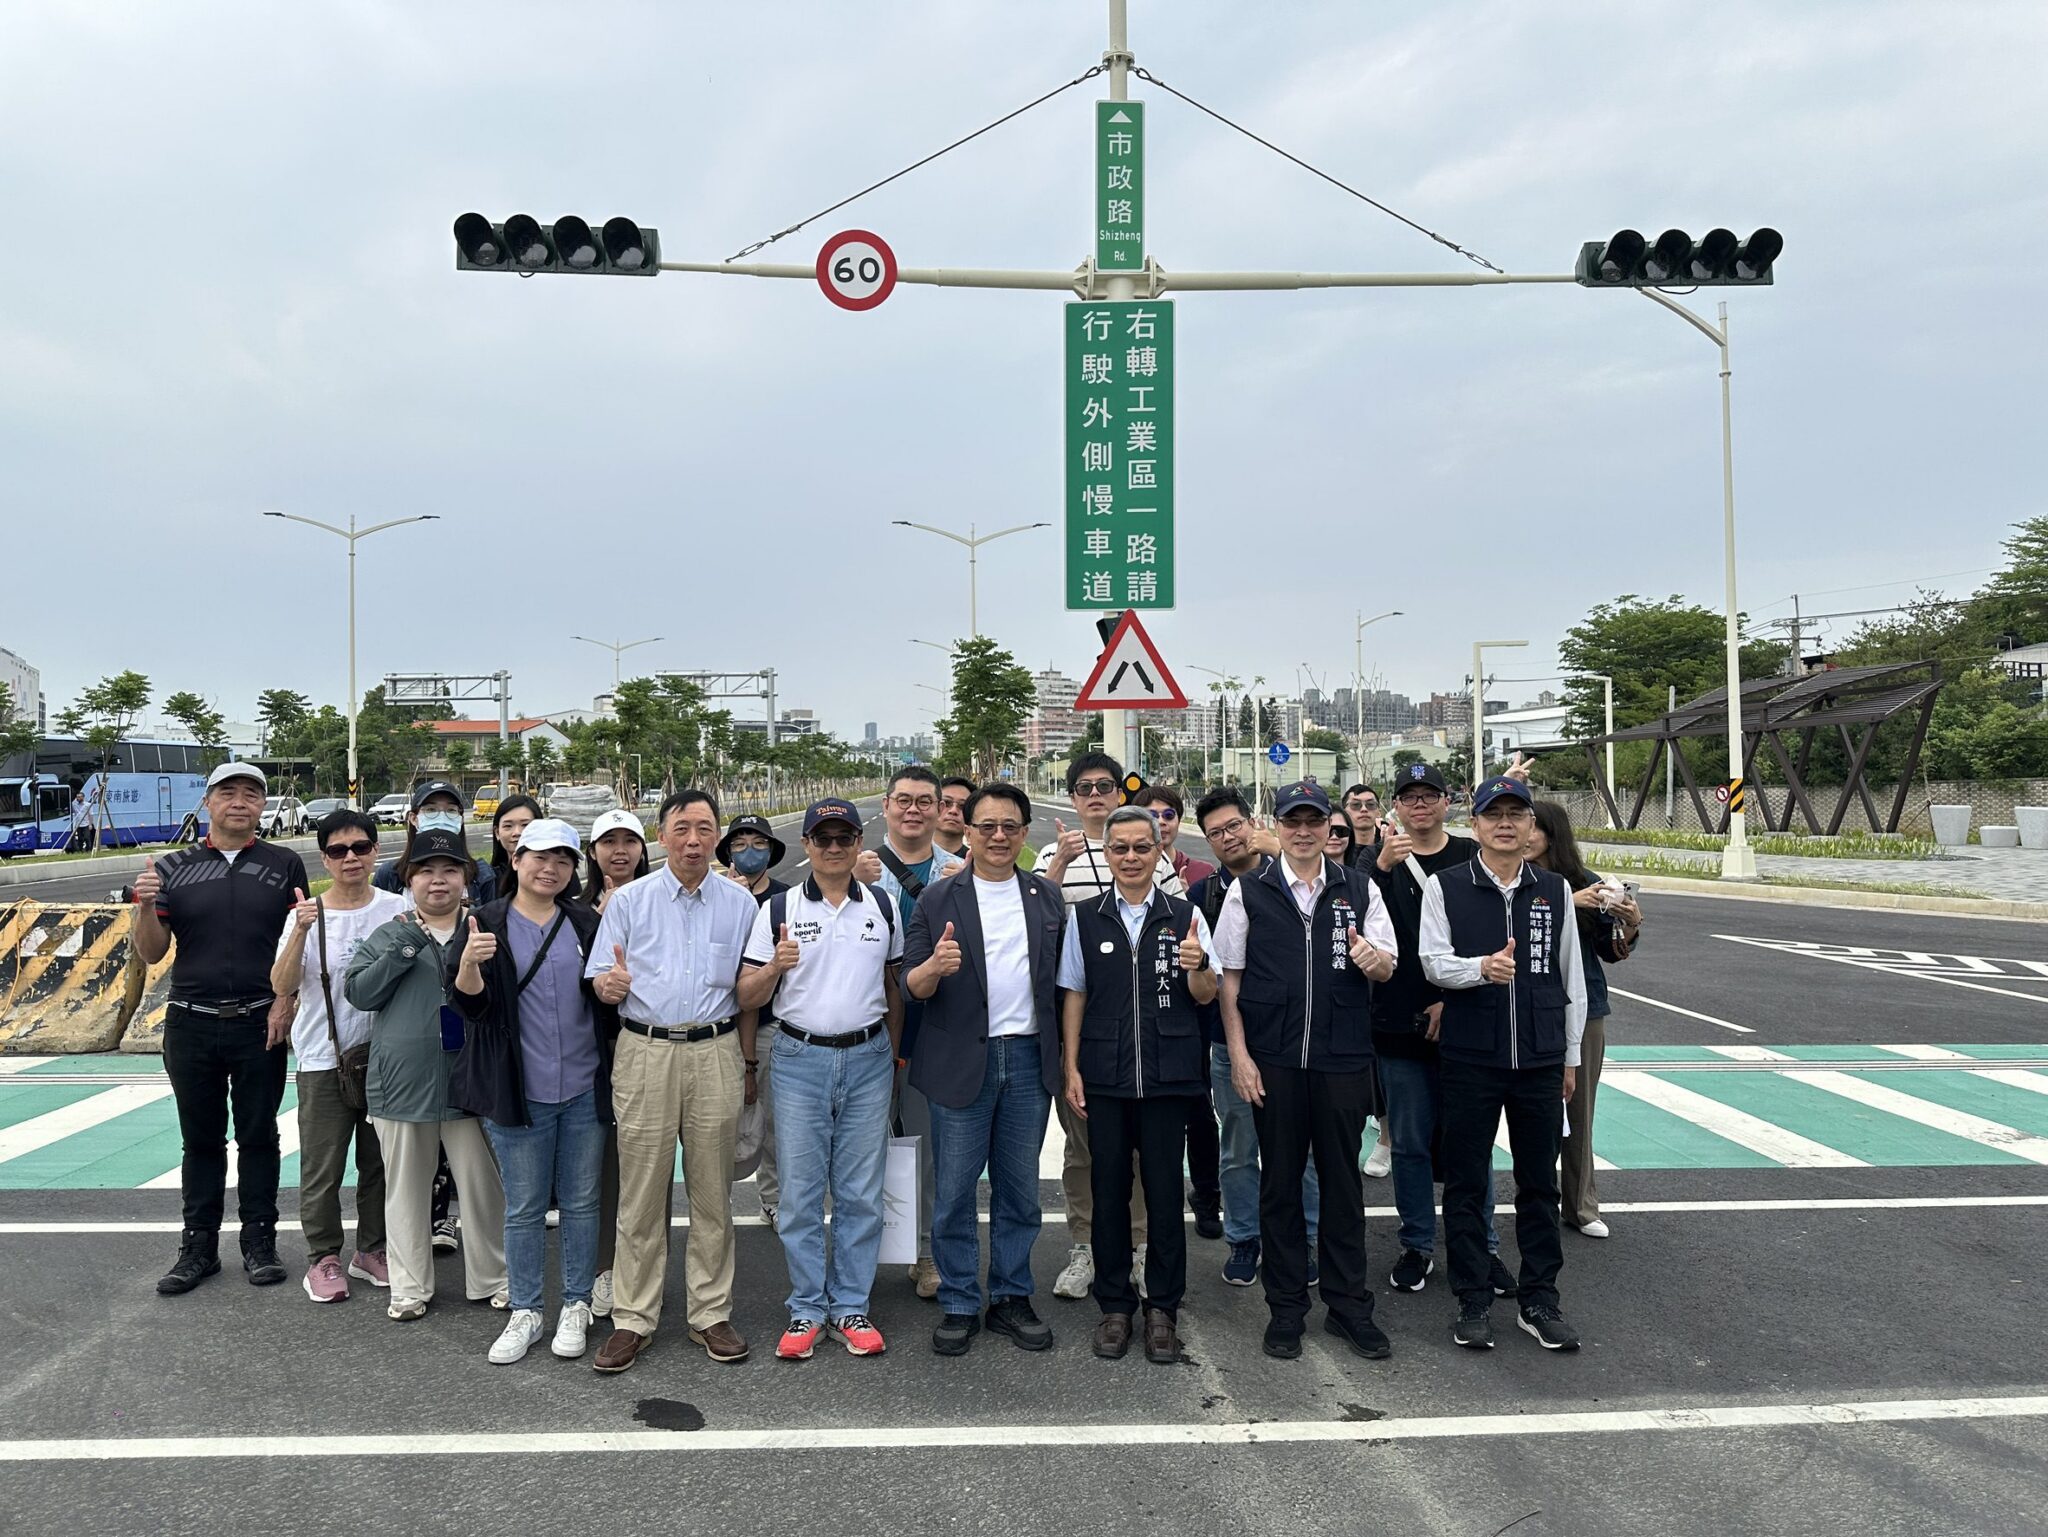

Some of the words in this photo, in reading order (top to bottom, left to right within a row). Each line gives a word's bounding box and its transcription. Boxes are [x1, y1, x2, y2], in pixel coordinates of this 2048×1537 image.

[1107, 131, 1133, 224] 市政路
[1100, 229, 1141, 243] Shizheng
[1114, 250, 1127, 262] Rd.
[833, 257, 880, 283] 60
[1081, 310, 1113, 602] 行駛外側慢車道
[1126, 308, 1158, 602] 右轉工業區一路請
[816, 805, 848, 816] Taiwan
[794, 927, 823, 937] sportif
